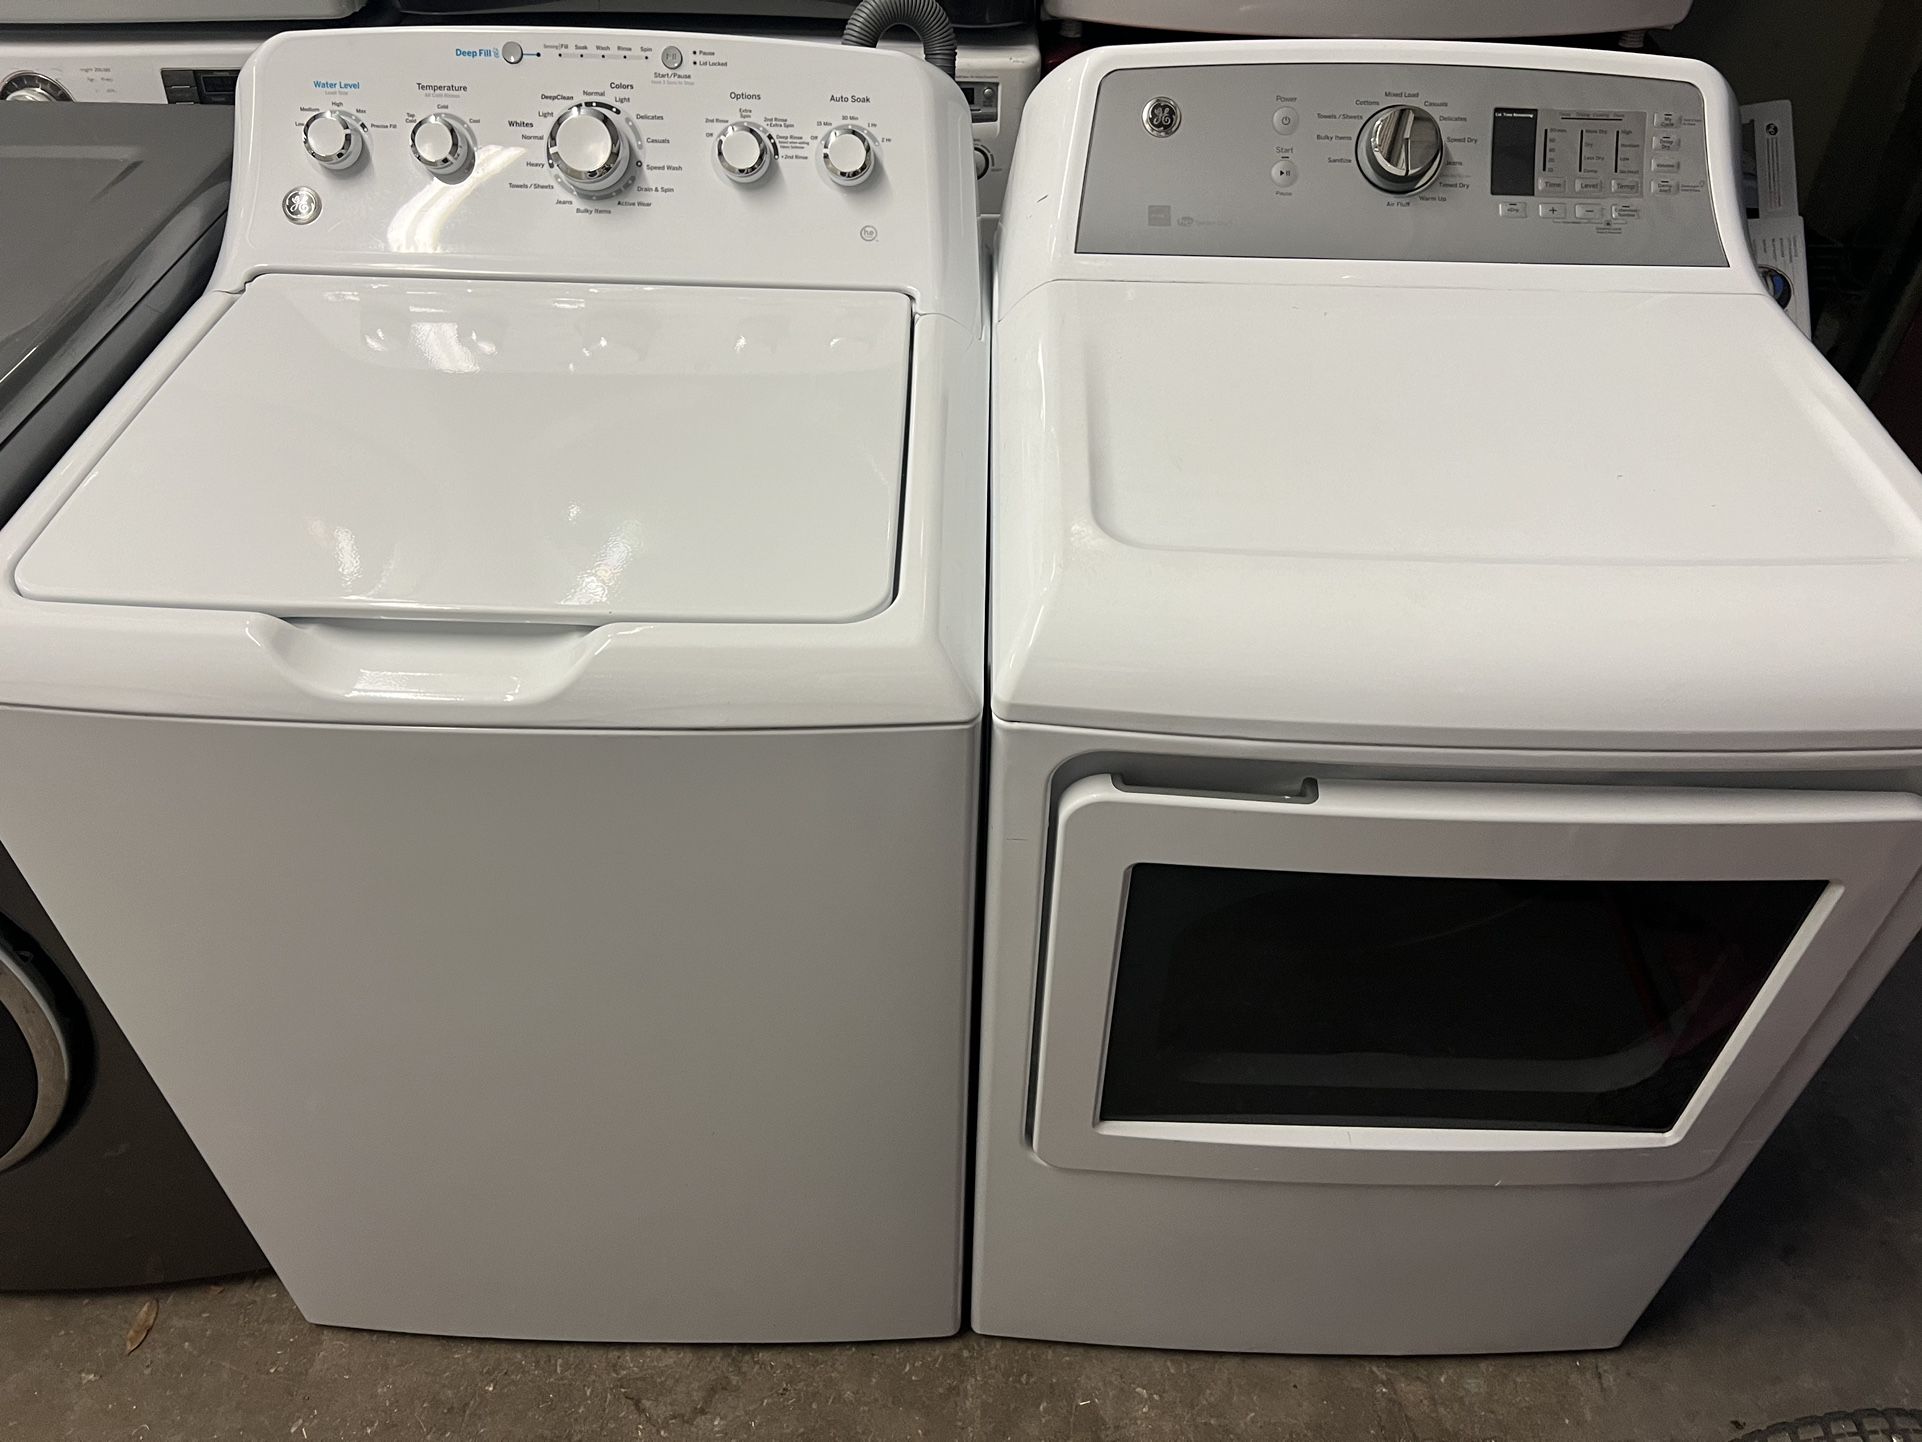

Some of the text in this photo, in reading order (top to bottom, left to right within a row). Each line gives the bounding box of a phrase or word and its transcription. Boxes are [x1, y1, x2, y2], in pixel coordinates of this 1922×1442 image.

[455, 48, 492, 58] Deep Fill
[313, 80, 360, 90] Water Level
[416, 82, 468, 92] Temperature
[609, 82, 634, 90] Colors
[541, 94, 574, 102] DeepClean
[729, 91, 761, 100] Options
[829, 94, 871, 103] Auto Soak
[508, 120, 534, 128] Whites
